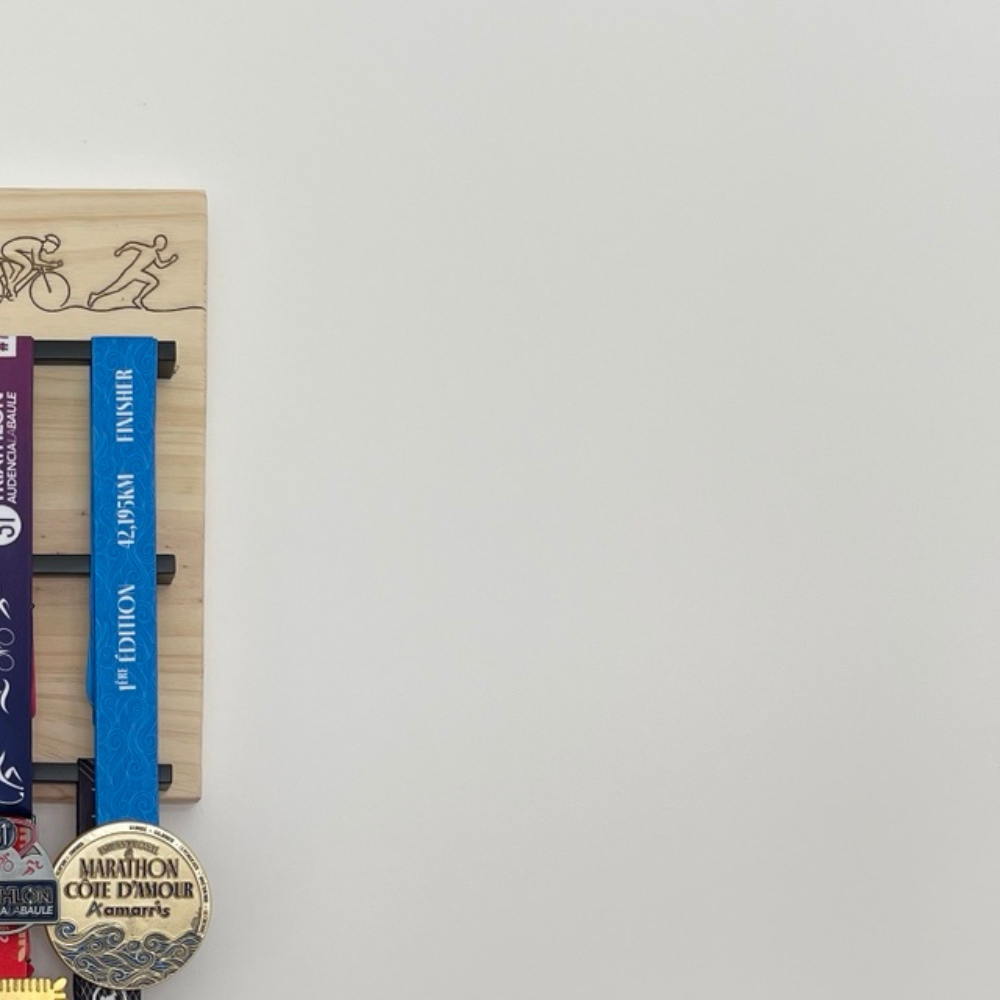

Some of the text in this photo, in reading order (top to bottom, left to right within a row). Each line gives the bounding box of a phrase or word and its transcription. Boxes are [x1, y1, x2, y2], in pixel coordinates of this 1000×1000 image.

[116, 369, 134, 442] FINISHER
[117, 474, 137, 549] 42,195KM
[114, 584, 136, 662] ÉDITION
[64, 878, 110, 899] CÔTE
[116, 880, 194, 899] D'AMOUR
[79, 857, 179, 879] MARATHON
